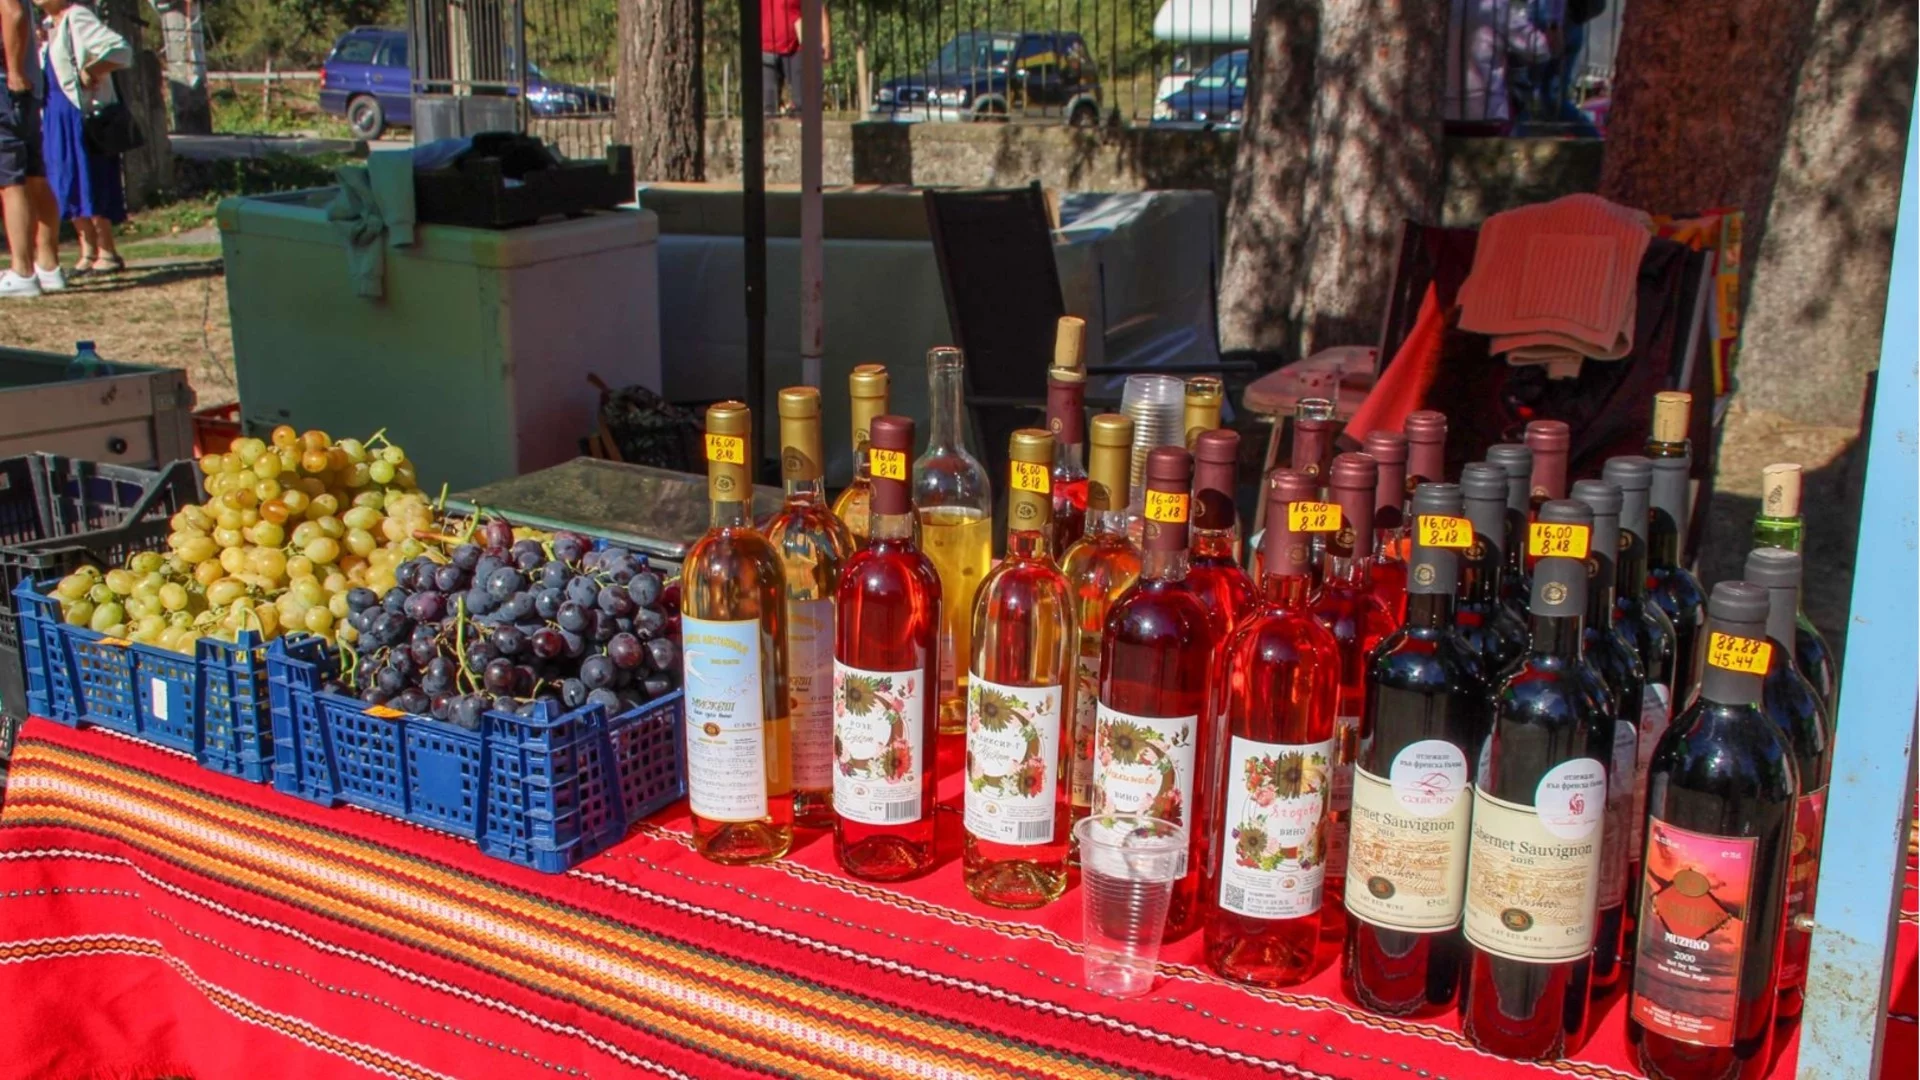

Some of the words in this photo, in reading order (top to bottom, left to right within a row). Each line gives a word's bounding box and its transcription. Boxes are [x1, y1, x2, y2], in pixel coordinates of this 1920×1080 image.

[1016, 461, 1041, 475] 16.00
[1021, 475, 1041, 489] 8.18
[1151, 493, 1180, 505] 16.00
[1293, 500, 1328, 513] 16.00
[1154, 506, 1180, 519] 8.18
[1299, 514, 1328, 531] 8.18
[1423, 515, 1458, 530] 16.00
[1429, 530, 1459, 545] 8.18
[1536, 525, 1573, 540] 16.00
[1541, 539, 1570, 555] 8.18
[1716, 634, 1762, 655] 88.88
[1713, 650, 1754, 669] 45.44
[1413, 760, 1443, 770] френска
[1382, 811, 1456, 834] Sauvignon
[1518, 841, 1593, 860] Sauvignon
[1510, 855, 1535, 866] 2016
[1673, 950, 1697, 964] 2000
